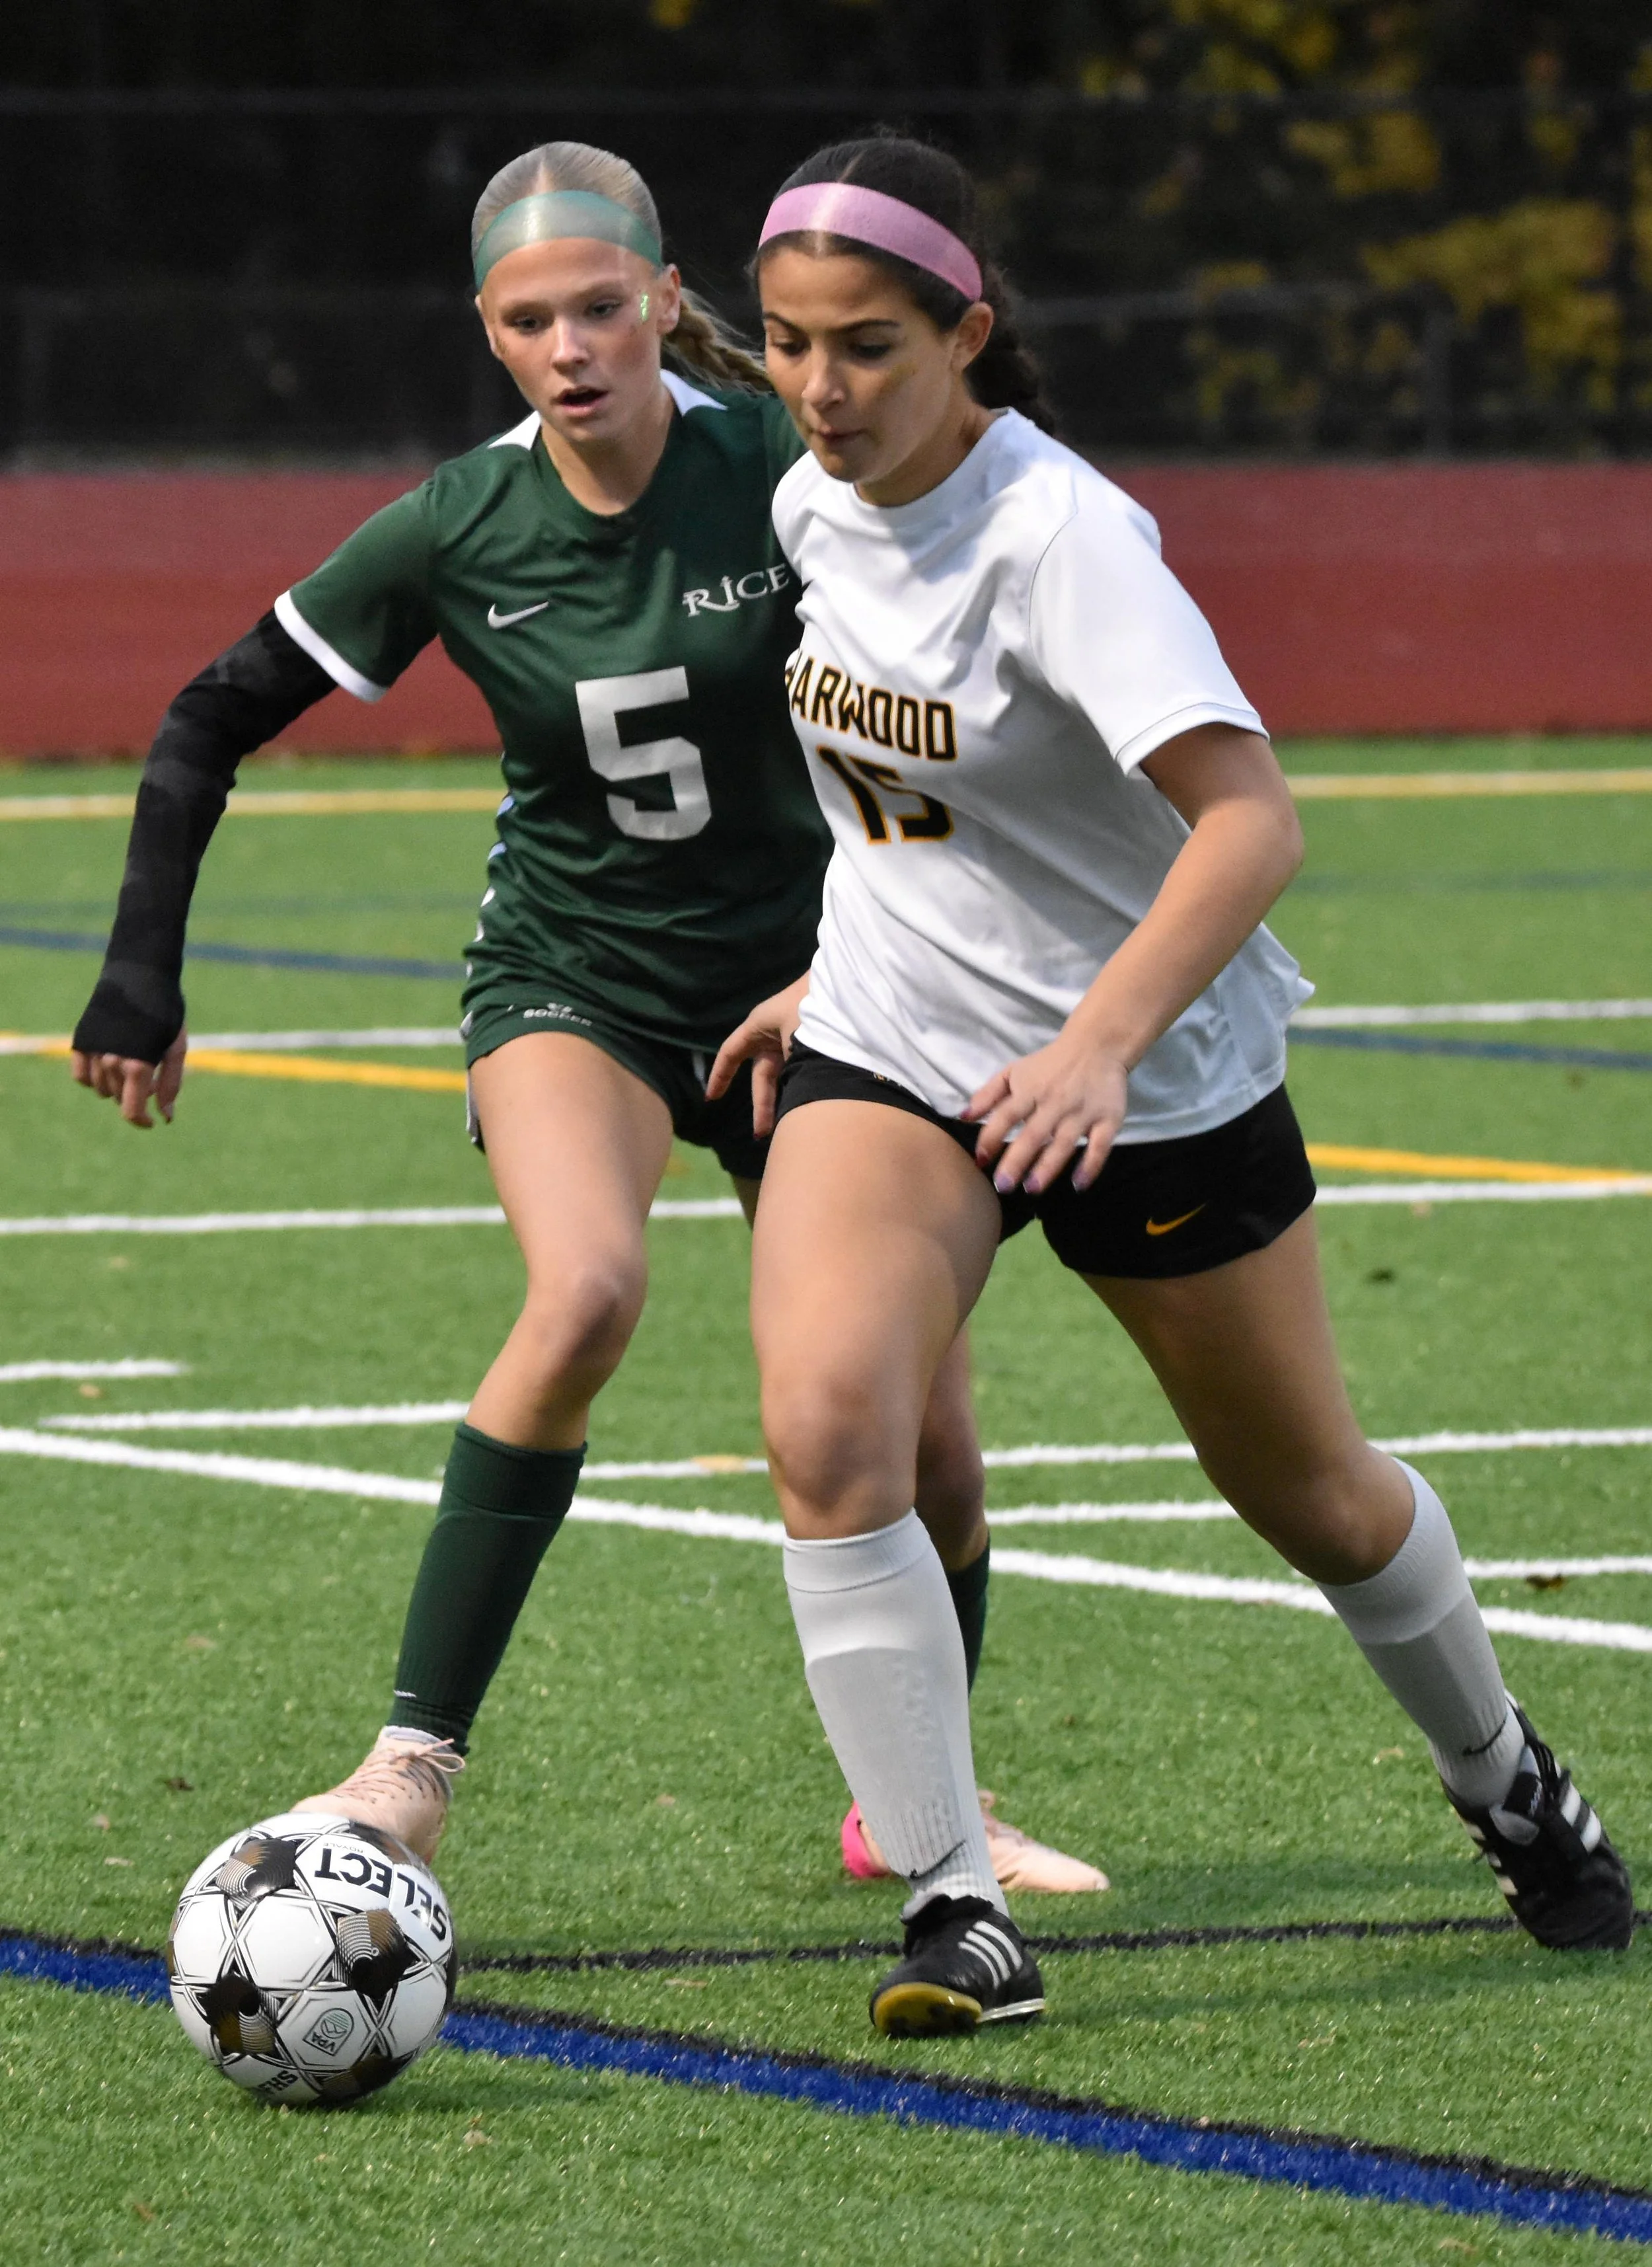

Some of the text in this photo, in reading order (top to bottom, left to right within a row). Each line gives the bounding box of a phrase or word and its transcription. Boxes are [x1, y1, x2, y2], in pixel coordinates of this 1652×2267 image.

[682, 562, 790, 617] RICE
[576, 665, 712, 841] 5
[815, 742, 955, 845] 15
[315, 1848, 447, 1941] SELECT
